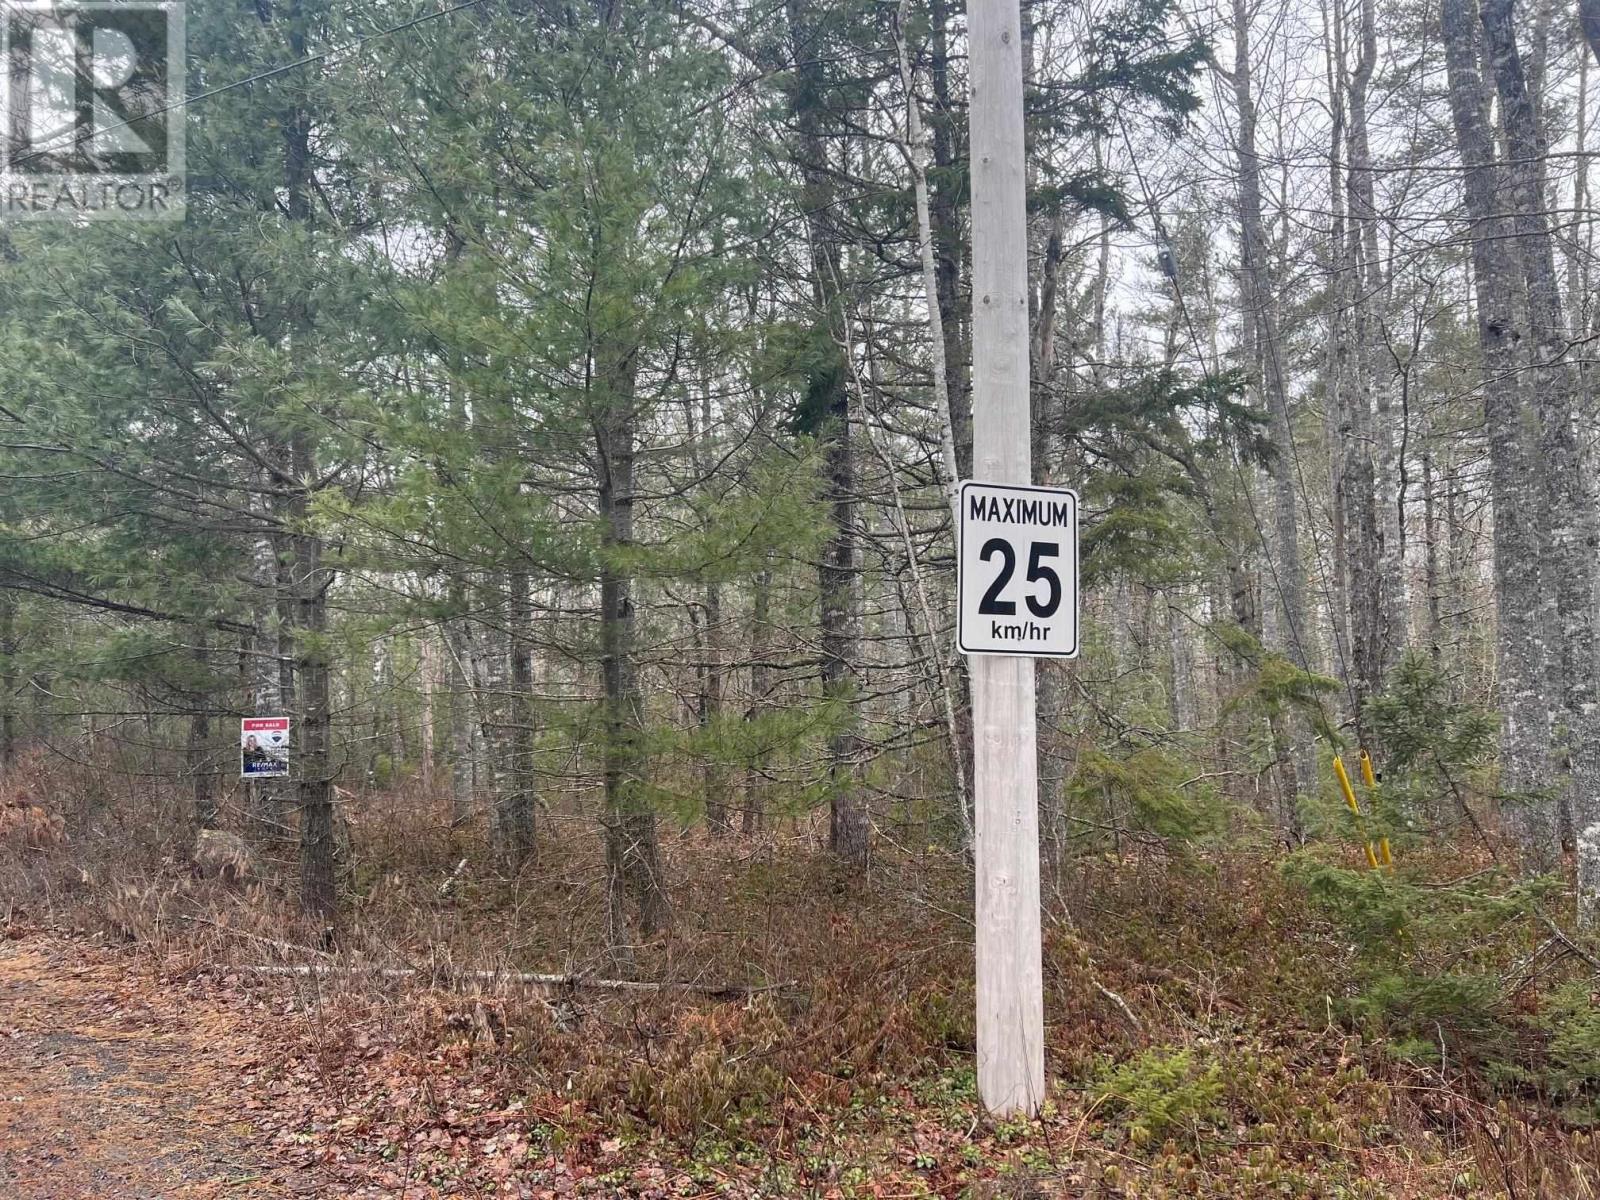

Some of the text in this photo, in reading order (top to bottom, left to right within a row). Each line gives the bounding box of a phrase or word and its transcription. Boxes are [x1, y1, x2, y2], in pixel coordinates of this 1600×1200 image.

[970, 495, 1067, 527] MAXIMUM
[978, 538, 1062, 618] 25
[991, 620, 1051, 641] km/hr
